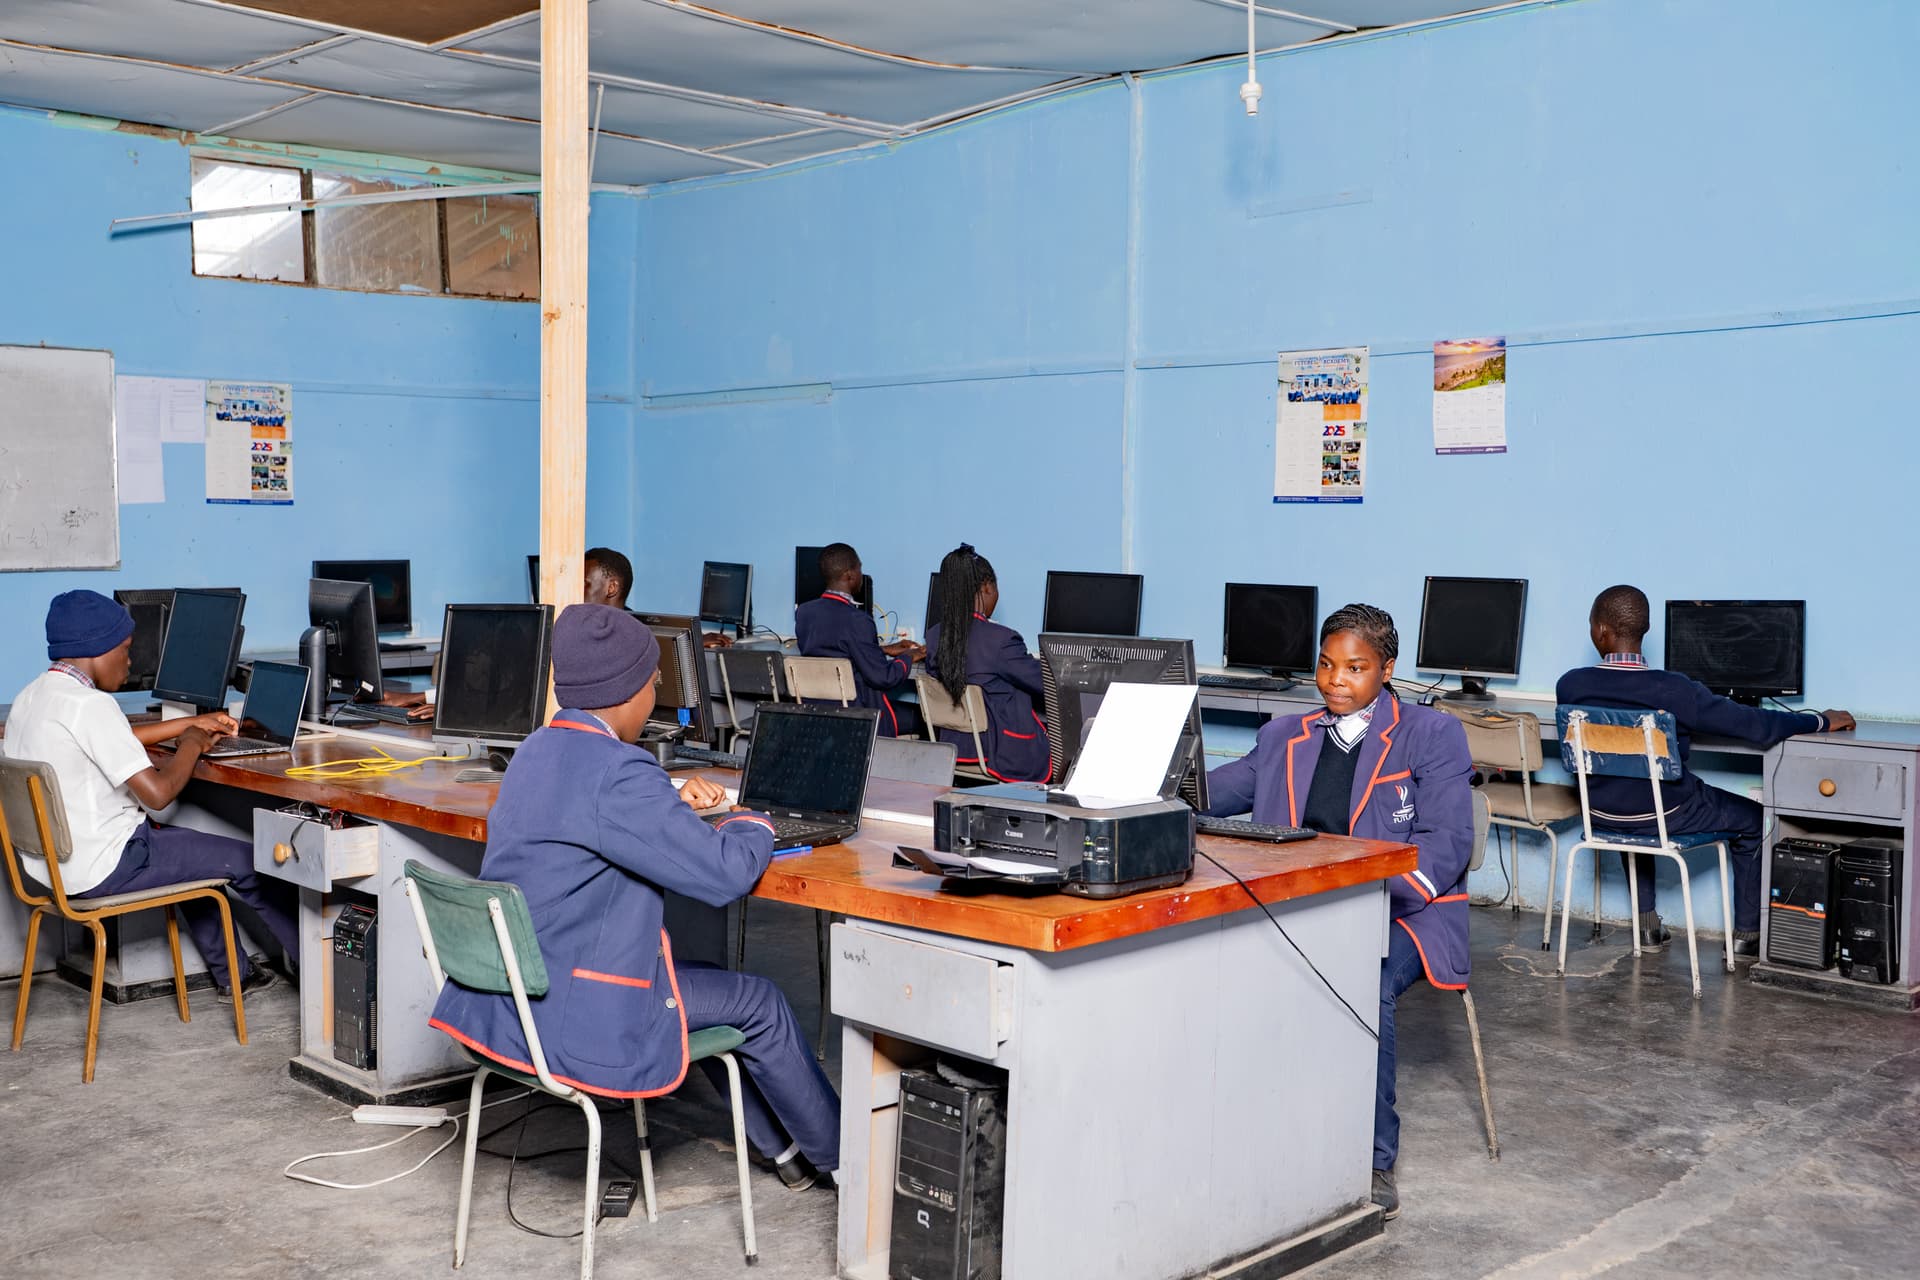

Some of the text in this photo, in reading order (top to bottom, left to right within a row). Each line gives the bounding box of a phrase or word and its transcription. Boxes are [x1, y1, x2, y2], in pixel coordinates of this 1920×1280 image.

[1323, 425, 1345, 436] 2025
[251, 441, 273, 451] 2025
[1091, 648, 1120, 660] DELL
[1005, 830, 1023, 838] Canon
